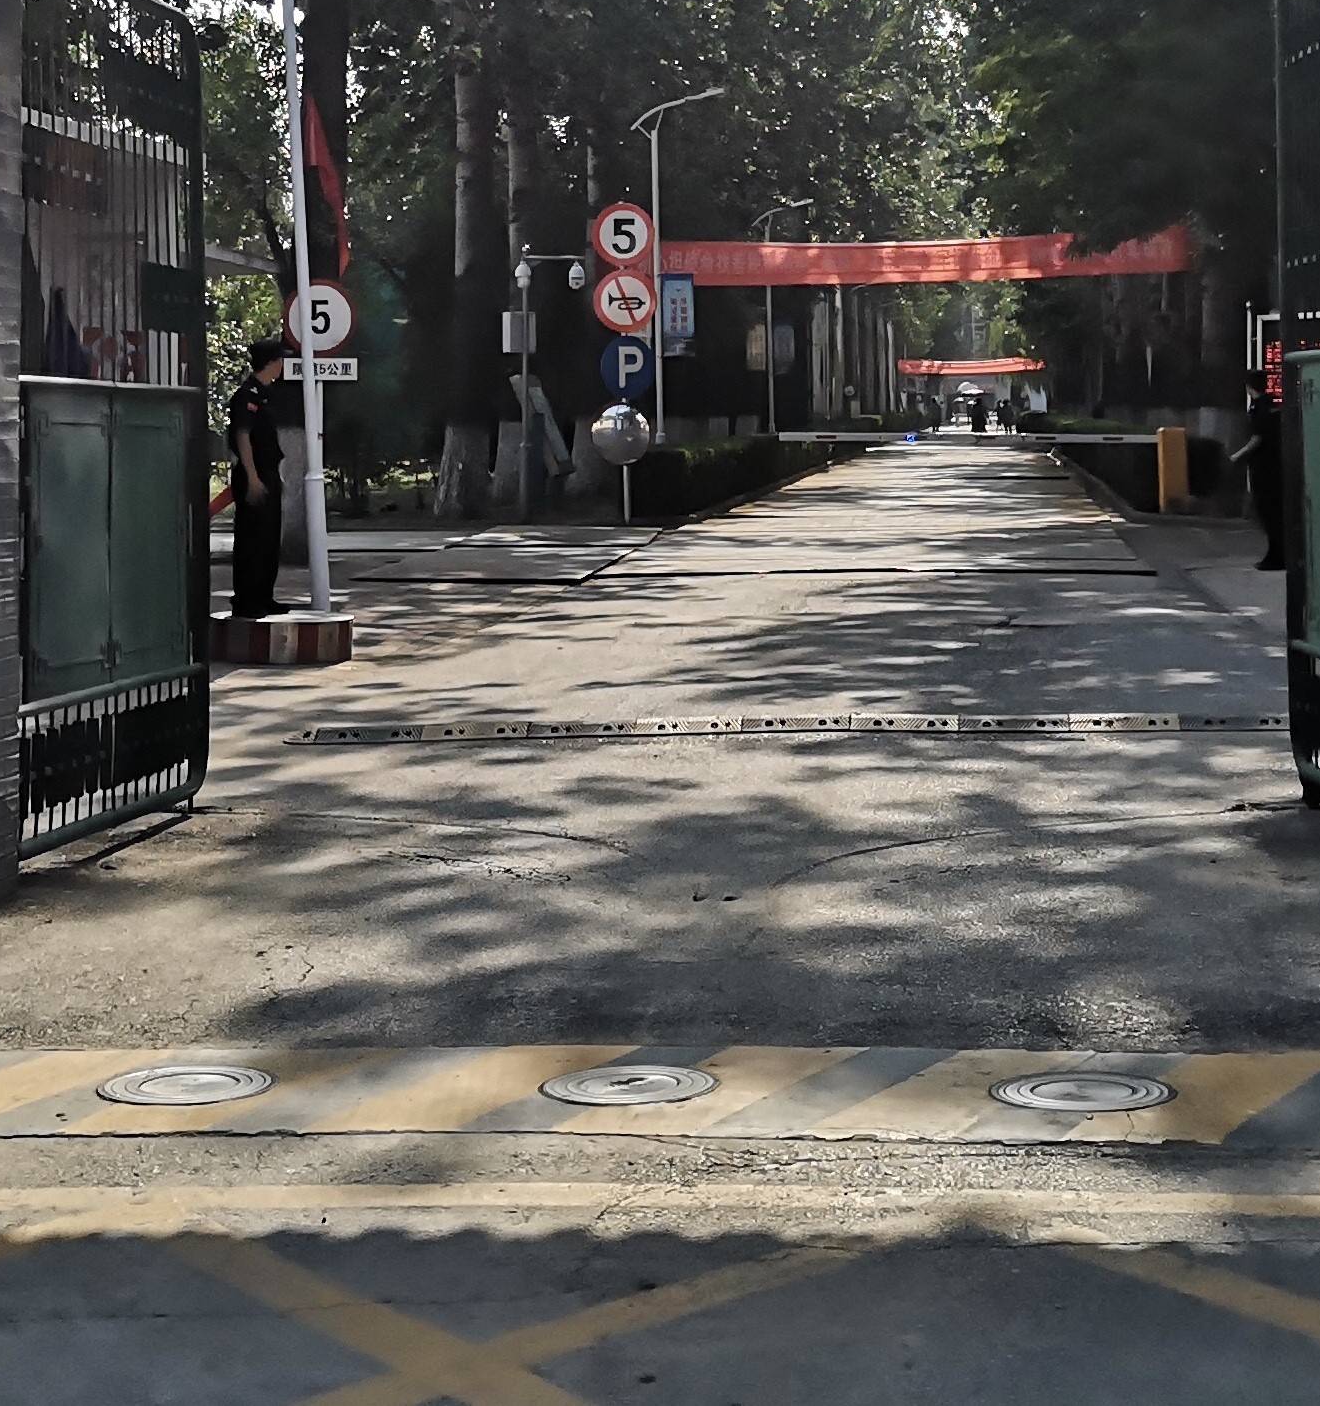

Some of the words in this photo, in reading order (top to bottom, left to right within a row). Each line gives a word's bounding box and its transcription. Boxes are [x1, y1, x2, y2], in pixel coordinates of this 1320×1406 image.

[611, 217, 637, 255] 5
[310, 299, 331, 335] 5
[617, 345, 644, 389] P
